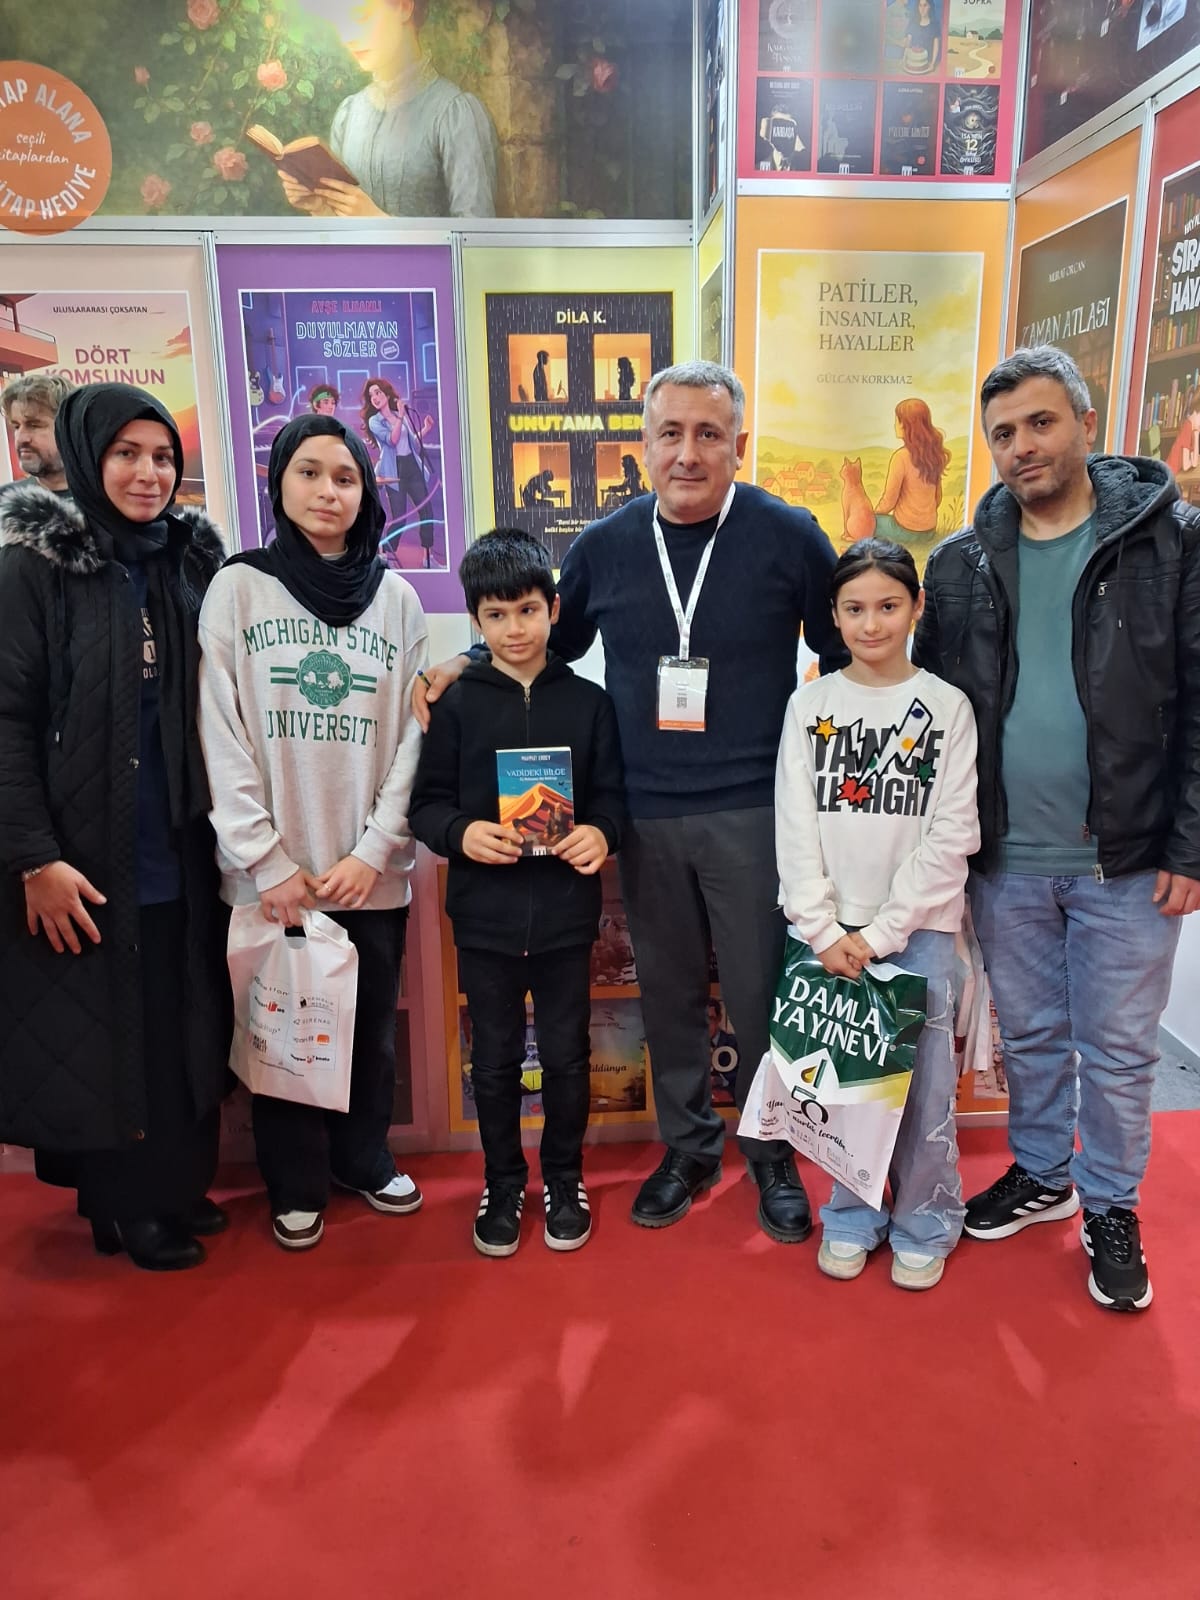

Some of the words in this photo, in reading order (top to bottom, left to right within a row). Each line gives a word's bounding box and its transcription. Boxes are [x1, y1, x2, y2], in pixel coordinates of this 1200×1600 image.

[0, 78, 28, 112] AP
[34, 83, 92, 144] ALANA
[965, 140, 978, 151] 12
[0, 148, 70, 168] itaplardan
[39, 163, 96, 220] HEDİYE
[818, 278, 918, 307] PATİLER,
[53, 306, 108, 314] ULUSLARARASI
[109, 306, 148, 315] ÇOKSATAN
[556, 308, 590, 323] DİLA
[594, 311, 607, 324] K.
[819, 307, 916, 329] İNSANLAR,
[1062, 297, 1111, 339] ATLASI
[296, 321, 398, 340] DUYULMAYAN
[323, 339, 377, 358] SÖZLER
[818, 333, 915, 352] HAYALLER
[75, 345, 131, 364] DÖRT
[816, 373, 860, 385] GÜLCAN
[861, 375, 913, 385] KORKMAZ
[509, 414, 604, 431] UNUTAMA
[242, 618, 339, 656] MICHIGAN
[346, 625, 398, 672] STATE
[789, 976, 881, 1035] DAMLA
[771, 997, 890, 1067] YAYINEVİ
